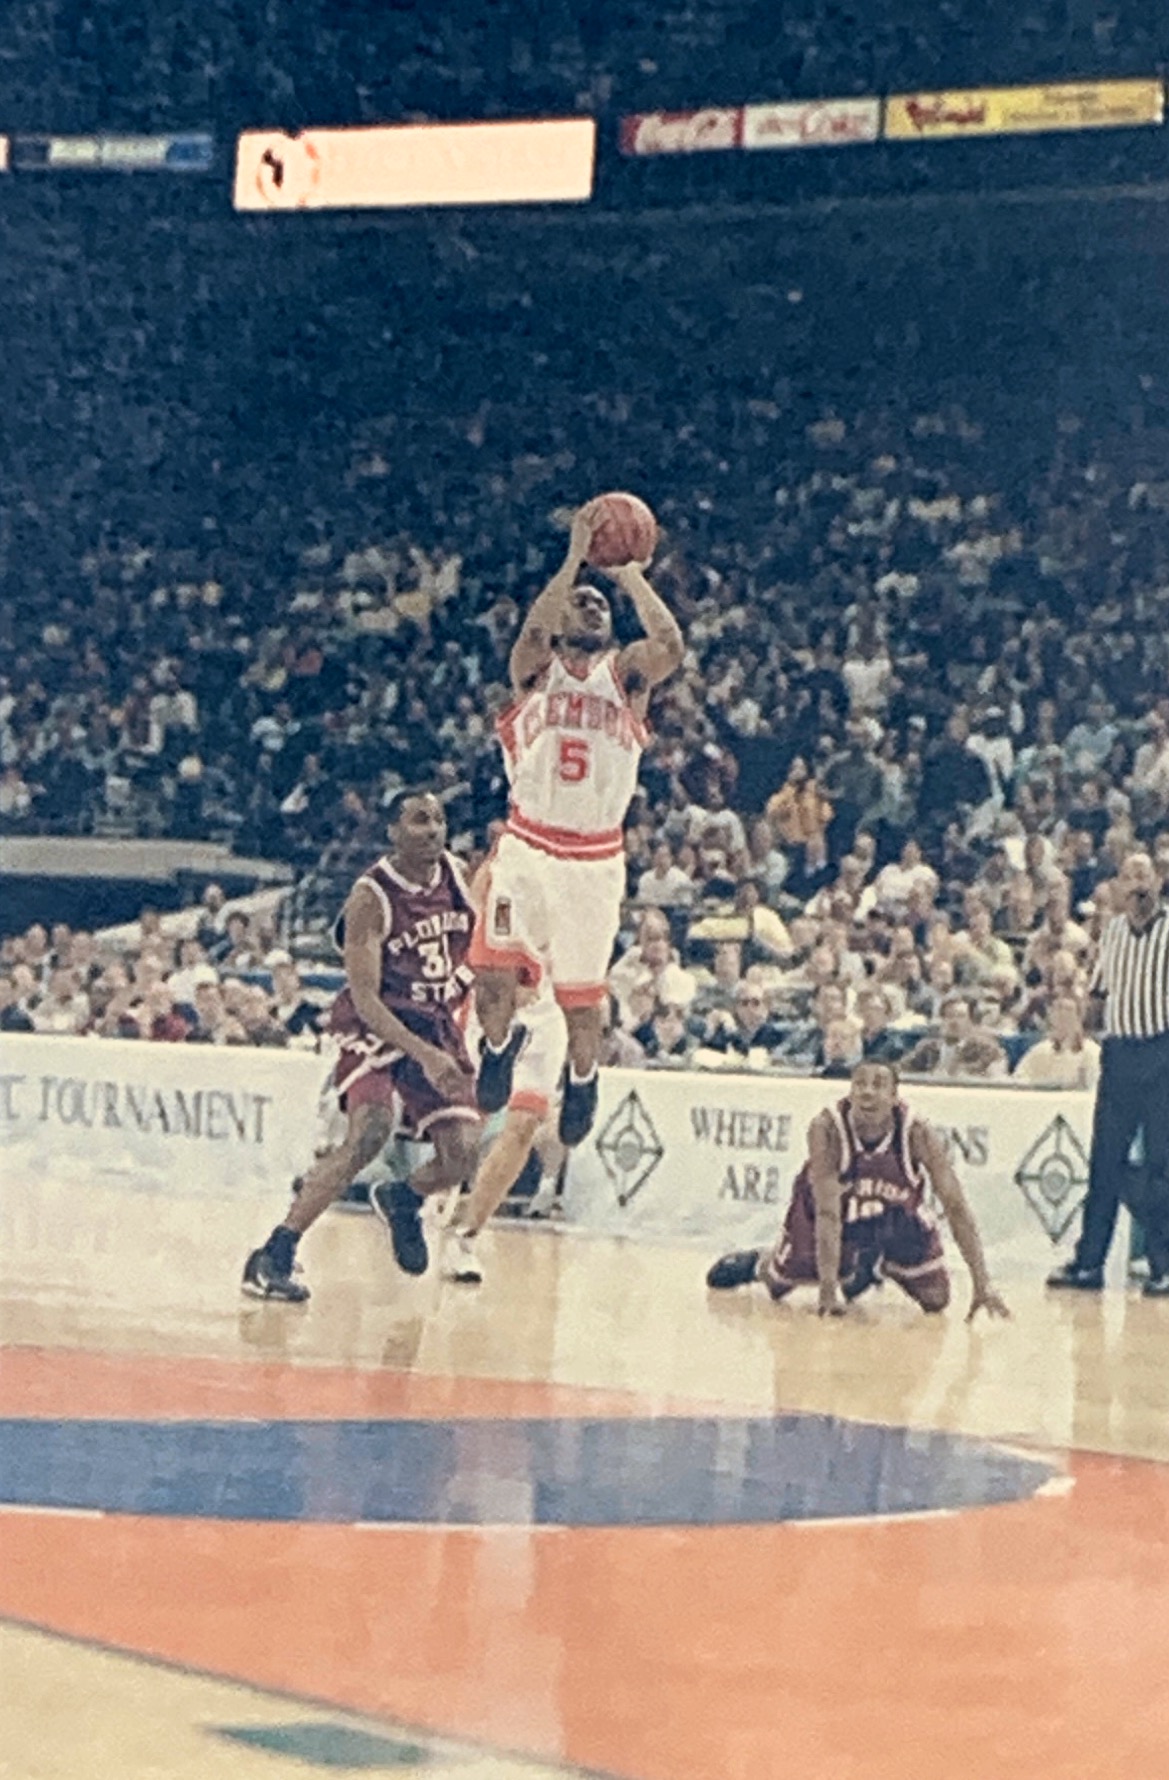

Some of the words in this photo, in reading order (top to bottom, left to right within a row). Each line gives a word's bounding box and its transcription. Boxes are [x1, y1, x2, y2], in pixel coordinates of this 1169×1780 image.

[560, 738, 589, 782] 5
[38, 1075, 273, 1144] TOURNAMENT
[689, 1106, 792, 1152] WHERE
[718, 1164, 780, 1204] ARE
